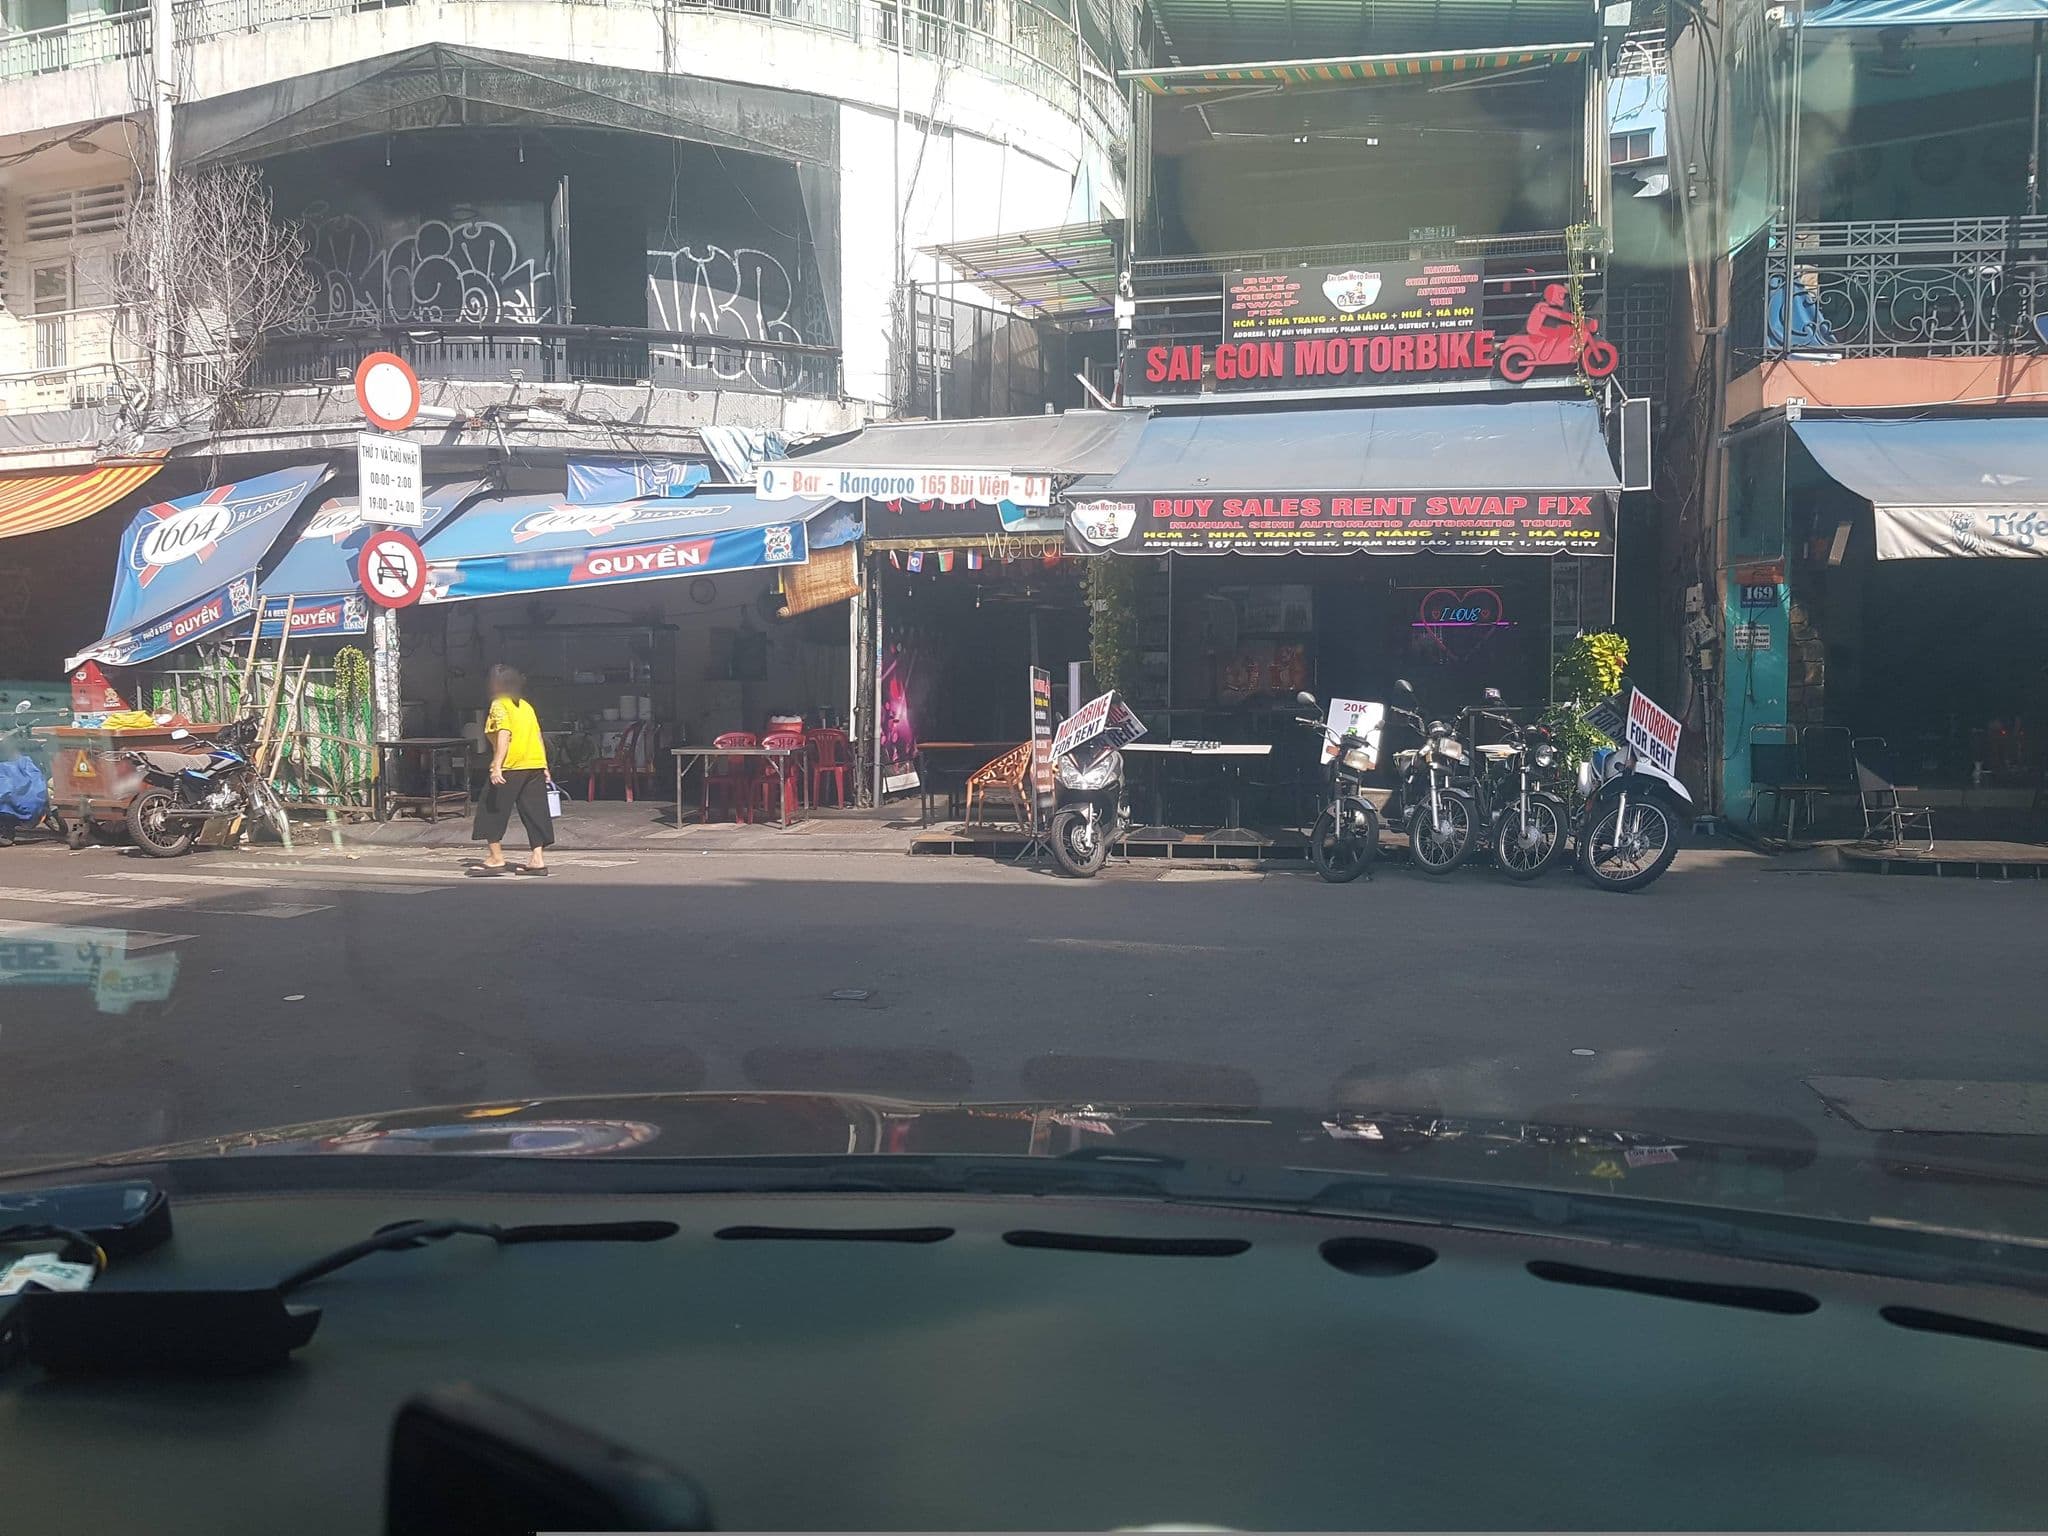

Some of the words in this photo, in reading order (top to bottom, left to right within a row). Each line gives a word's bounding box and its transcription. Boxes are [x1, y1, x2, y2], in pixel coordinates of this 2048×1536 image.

[1243, 275, 1288, 284] BUY
[1230, 283, 1301, 293] SALES
[1236, 291, 1295, 301] RENT
[1231, 299, 1299, 310] SWAP
[1247, 309, 1283, 317] FIX
[1233, 319, 1255, 328] HCM
[1267, 317, 1290, 326] NHA
[1292, 315, 1326, 324] TRANG
[1233, 330, 1266, 338] ADDRESS:
[1268, 329, 1281, 337] 167
[1398, 321, 1429, 330] DISTRICT
[1440, 320, 1456, 328] HCM
[1457, 319, 1474, 327] CITY
[1145, 344, 1203, 383] SAI
[1215, 341, 1284, 380] GON
[1293, 329, 1495, 376] MOTORBIKE
[375, 447, 379, 459] 7
[370, 472, 390, 486] 00:00
[397, 476, 412, 488] 2:00
[763, 471, 775, 493] Q
[792, 471, 821, 493] Bar
[839, 472, 915, 496] Kangoroo
[921, 474, 946, 494] 165
[951, 475, 975, 496] Bùi
[979, 475, 1009, 499] Viện
[1025, 477, 1047, 498] Q.1
[369, 496, 388, 510] 19:00
[1153, 499, 1213, 517] BUY
[1223, 499, 1321, 517] SALES
[1332, 497, 1417, 516] RENT
[1426, 496, 1528, 516] SWAP
[1538, 496, 1592, 515] FIX
[151, 512, 220, 555] 1664
[237, 491, 293, 522] BLANC
[544, 510, 615, 528] 1664
[642, 507, 713, 519] BLANC
[1169, 521, 1244, 529] MANUAL
[1248, 520, 1295, 529] SEMI
[1300, 520, 1403, 529] AUTOMATIC
[1408, 519, 1515, 528] AUTOMATIC
[1521, 519, 1572, 528] TOUR
[1143, 531, 1183, 539] HCM
[1253, 530, 1316, 538] TRANG
[1208, 541, 1231, 549] 167
[588, 544, 700, 576] QUYỀN
[1746, 586, 1774, 600] 169
[159, 621, 173, 634] BEER
[175, 605, 220, 637] QUYỀN
[291, 607, 336, 626] QUYỀN
[1440, 607, 1450, 622] I
[1449, 607, 1481, 622] LOVE
[1343, 703, 1368, 714] 20K
[1058, 695, 1109, 741] MOTORBIKE
[1631, 691, 1679, 752] MOTORBIKE
[1052, 740, 1070, 761] FOR
[1073, 718, 1102, 745] RENT
[1630, 721, 1648, 752] FOR
[1649, 739, 1673, 770] RENT
